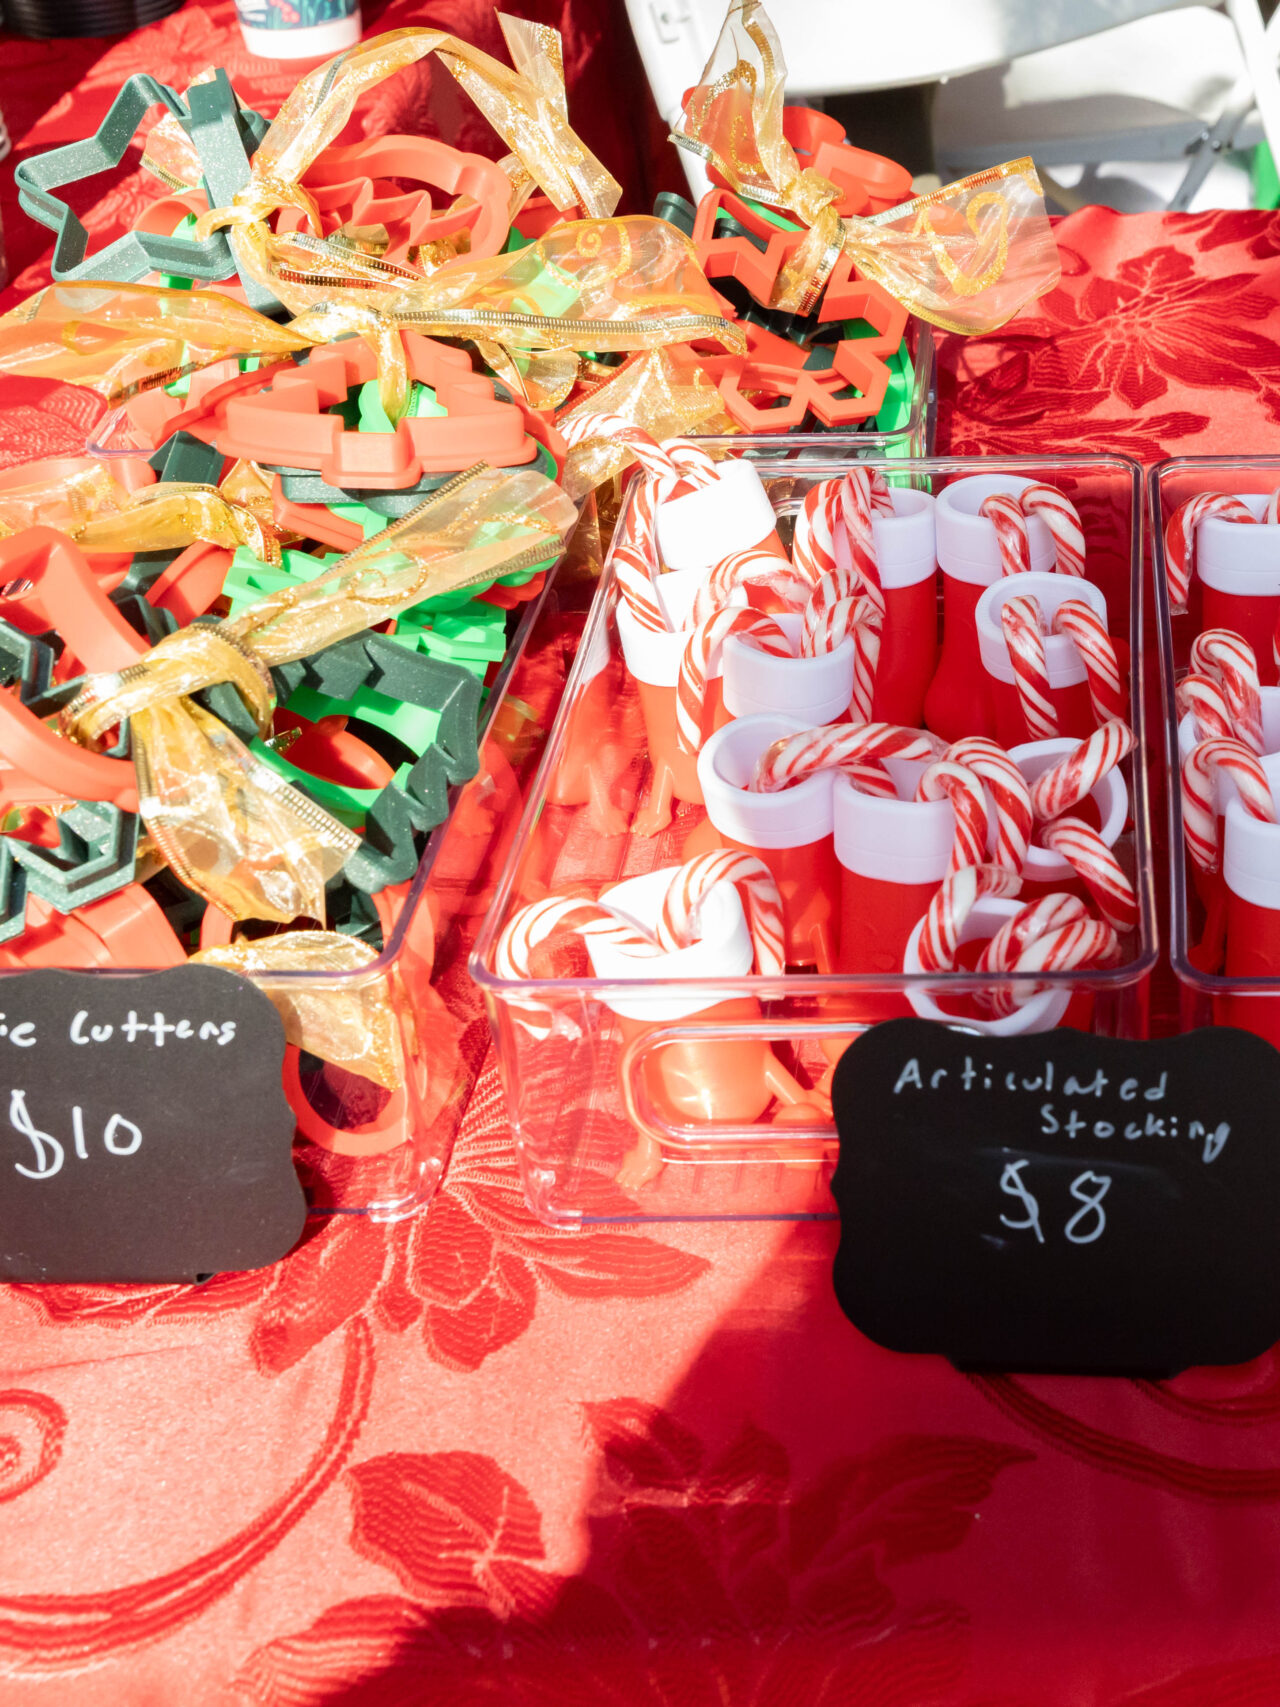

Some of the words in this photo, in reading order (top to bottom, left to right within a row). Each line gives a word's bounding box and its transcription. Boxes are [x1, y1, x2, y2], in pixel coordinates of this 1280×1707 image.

[893, 1056, 1168, 1101] Articulated
[9, 1088, 143, 1180] $10
[1040, 1103, 1231, 1164] Stocking
[1000, 1158, 1112, 1244] $8
